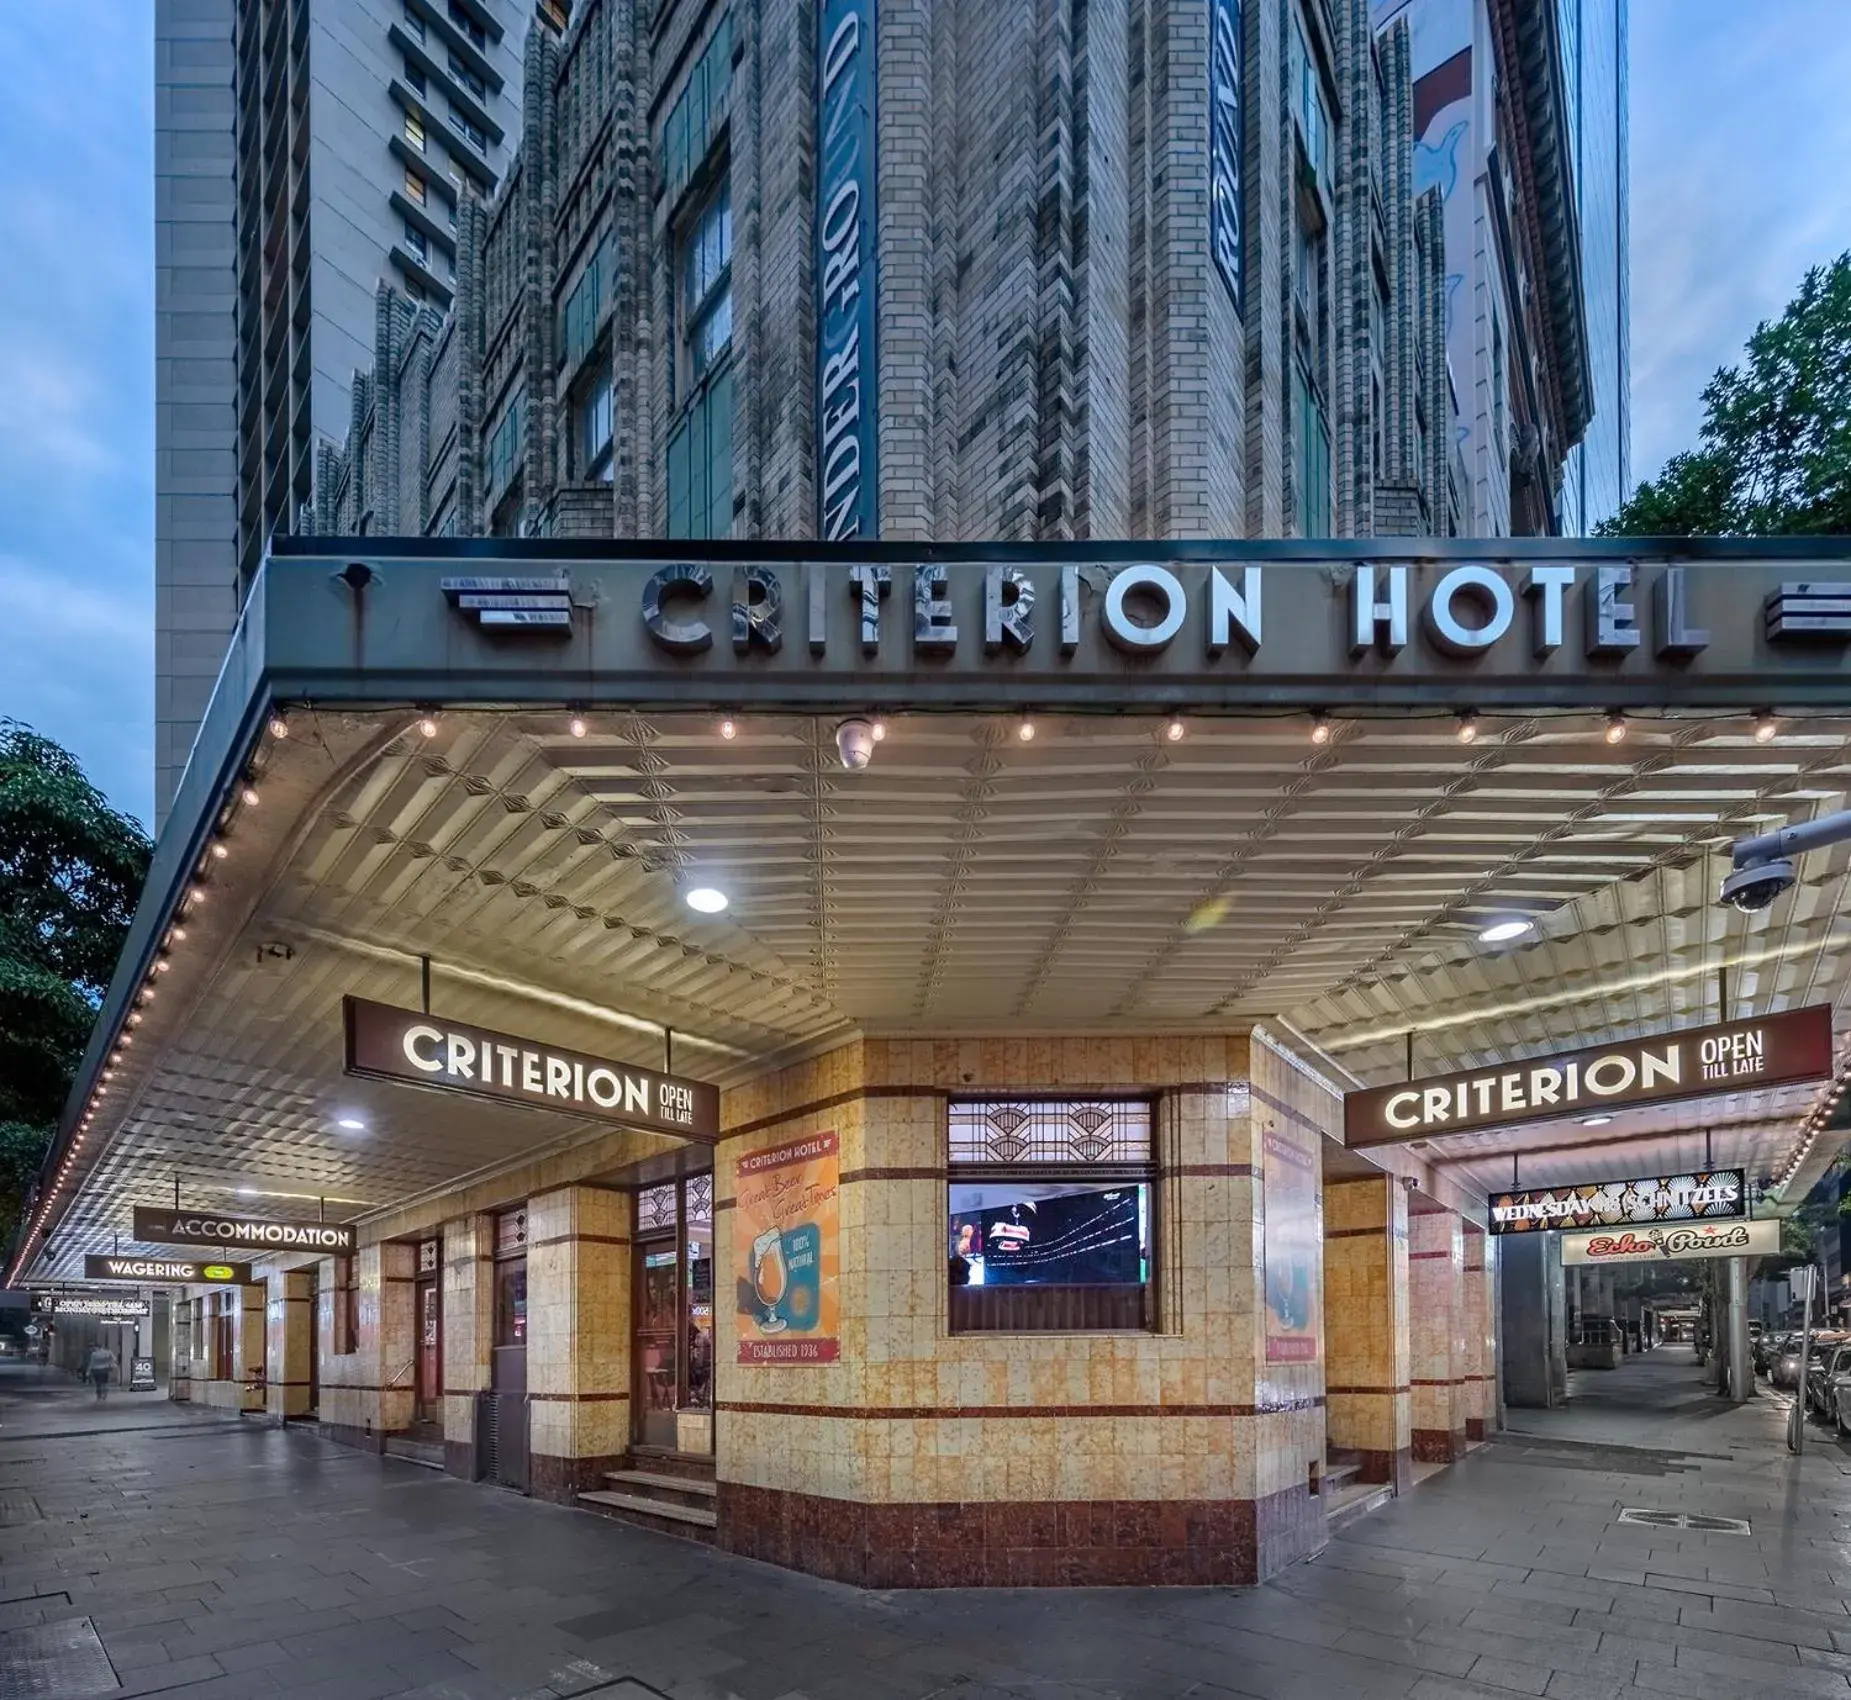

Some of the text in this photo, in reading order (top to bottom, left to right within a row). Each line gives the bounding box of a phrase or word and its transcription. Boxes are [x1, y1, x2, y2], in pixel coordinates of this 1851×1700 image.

[641, 563, 1710, 657] CRITERION HOTEL
[1700, 1030, 1763, 1066] OPEN
[402, 1025, 649, 1115] CRITERION
[1702, 1057, 1765, 1081] TILL LATE
[659, 1083, 693, 1111] OPEN
[1384, 1044, 1681, 1129] CRITERION
[660, 1105, 693, 1125] TILL LATE
[750, 1140, 822, 1169] CRITERION HOTEL
[1492, 1199, 1592, 1222] WEDNESDAY
[1627, 1184, 1738, 1212] SCHNITZELS
[172, 1219, 349, 1247] ACCOMMODATION
[1587, 1226, 1750, 1257] Echo Point
[108, 1260, 195, 1278] WAGERING
[753, 1343, 819, 1358] ESTABLISHED 1936
